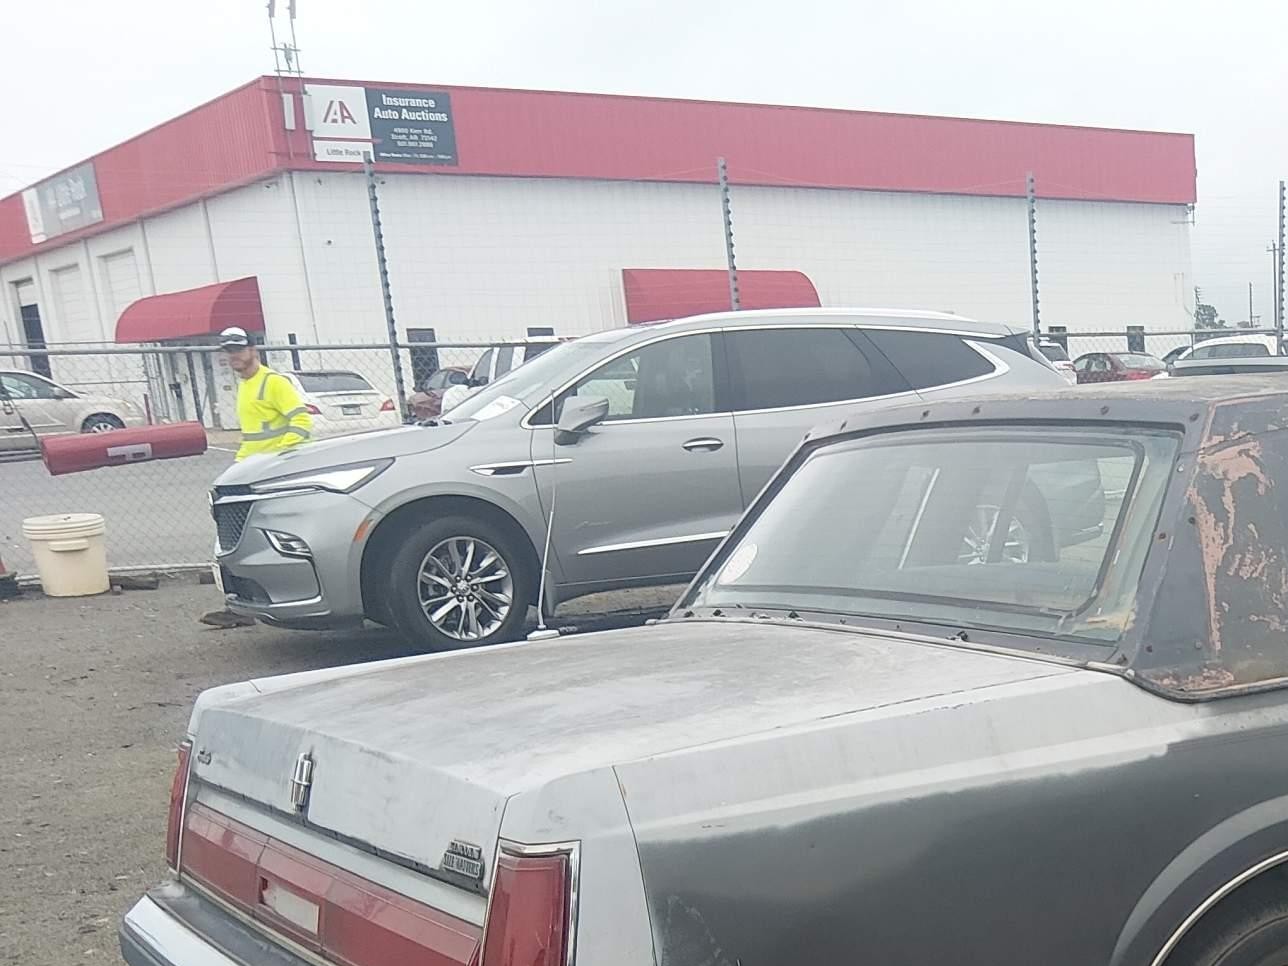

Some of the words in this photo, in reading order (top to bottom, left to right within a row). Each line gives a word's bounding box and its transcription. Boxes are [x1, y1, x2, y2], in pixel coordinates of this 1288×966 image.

[381, 94, 436, 108] Insurance
[374, 107, 399, 120] Auto
[401, 109, 448, 122] Auctions
[326, 147, 343, 157] Little
[344, 149, 361, 157] Rock
